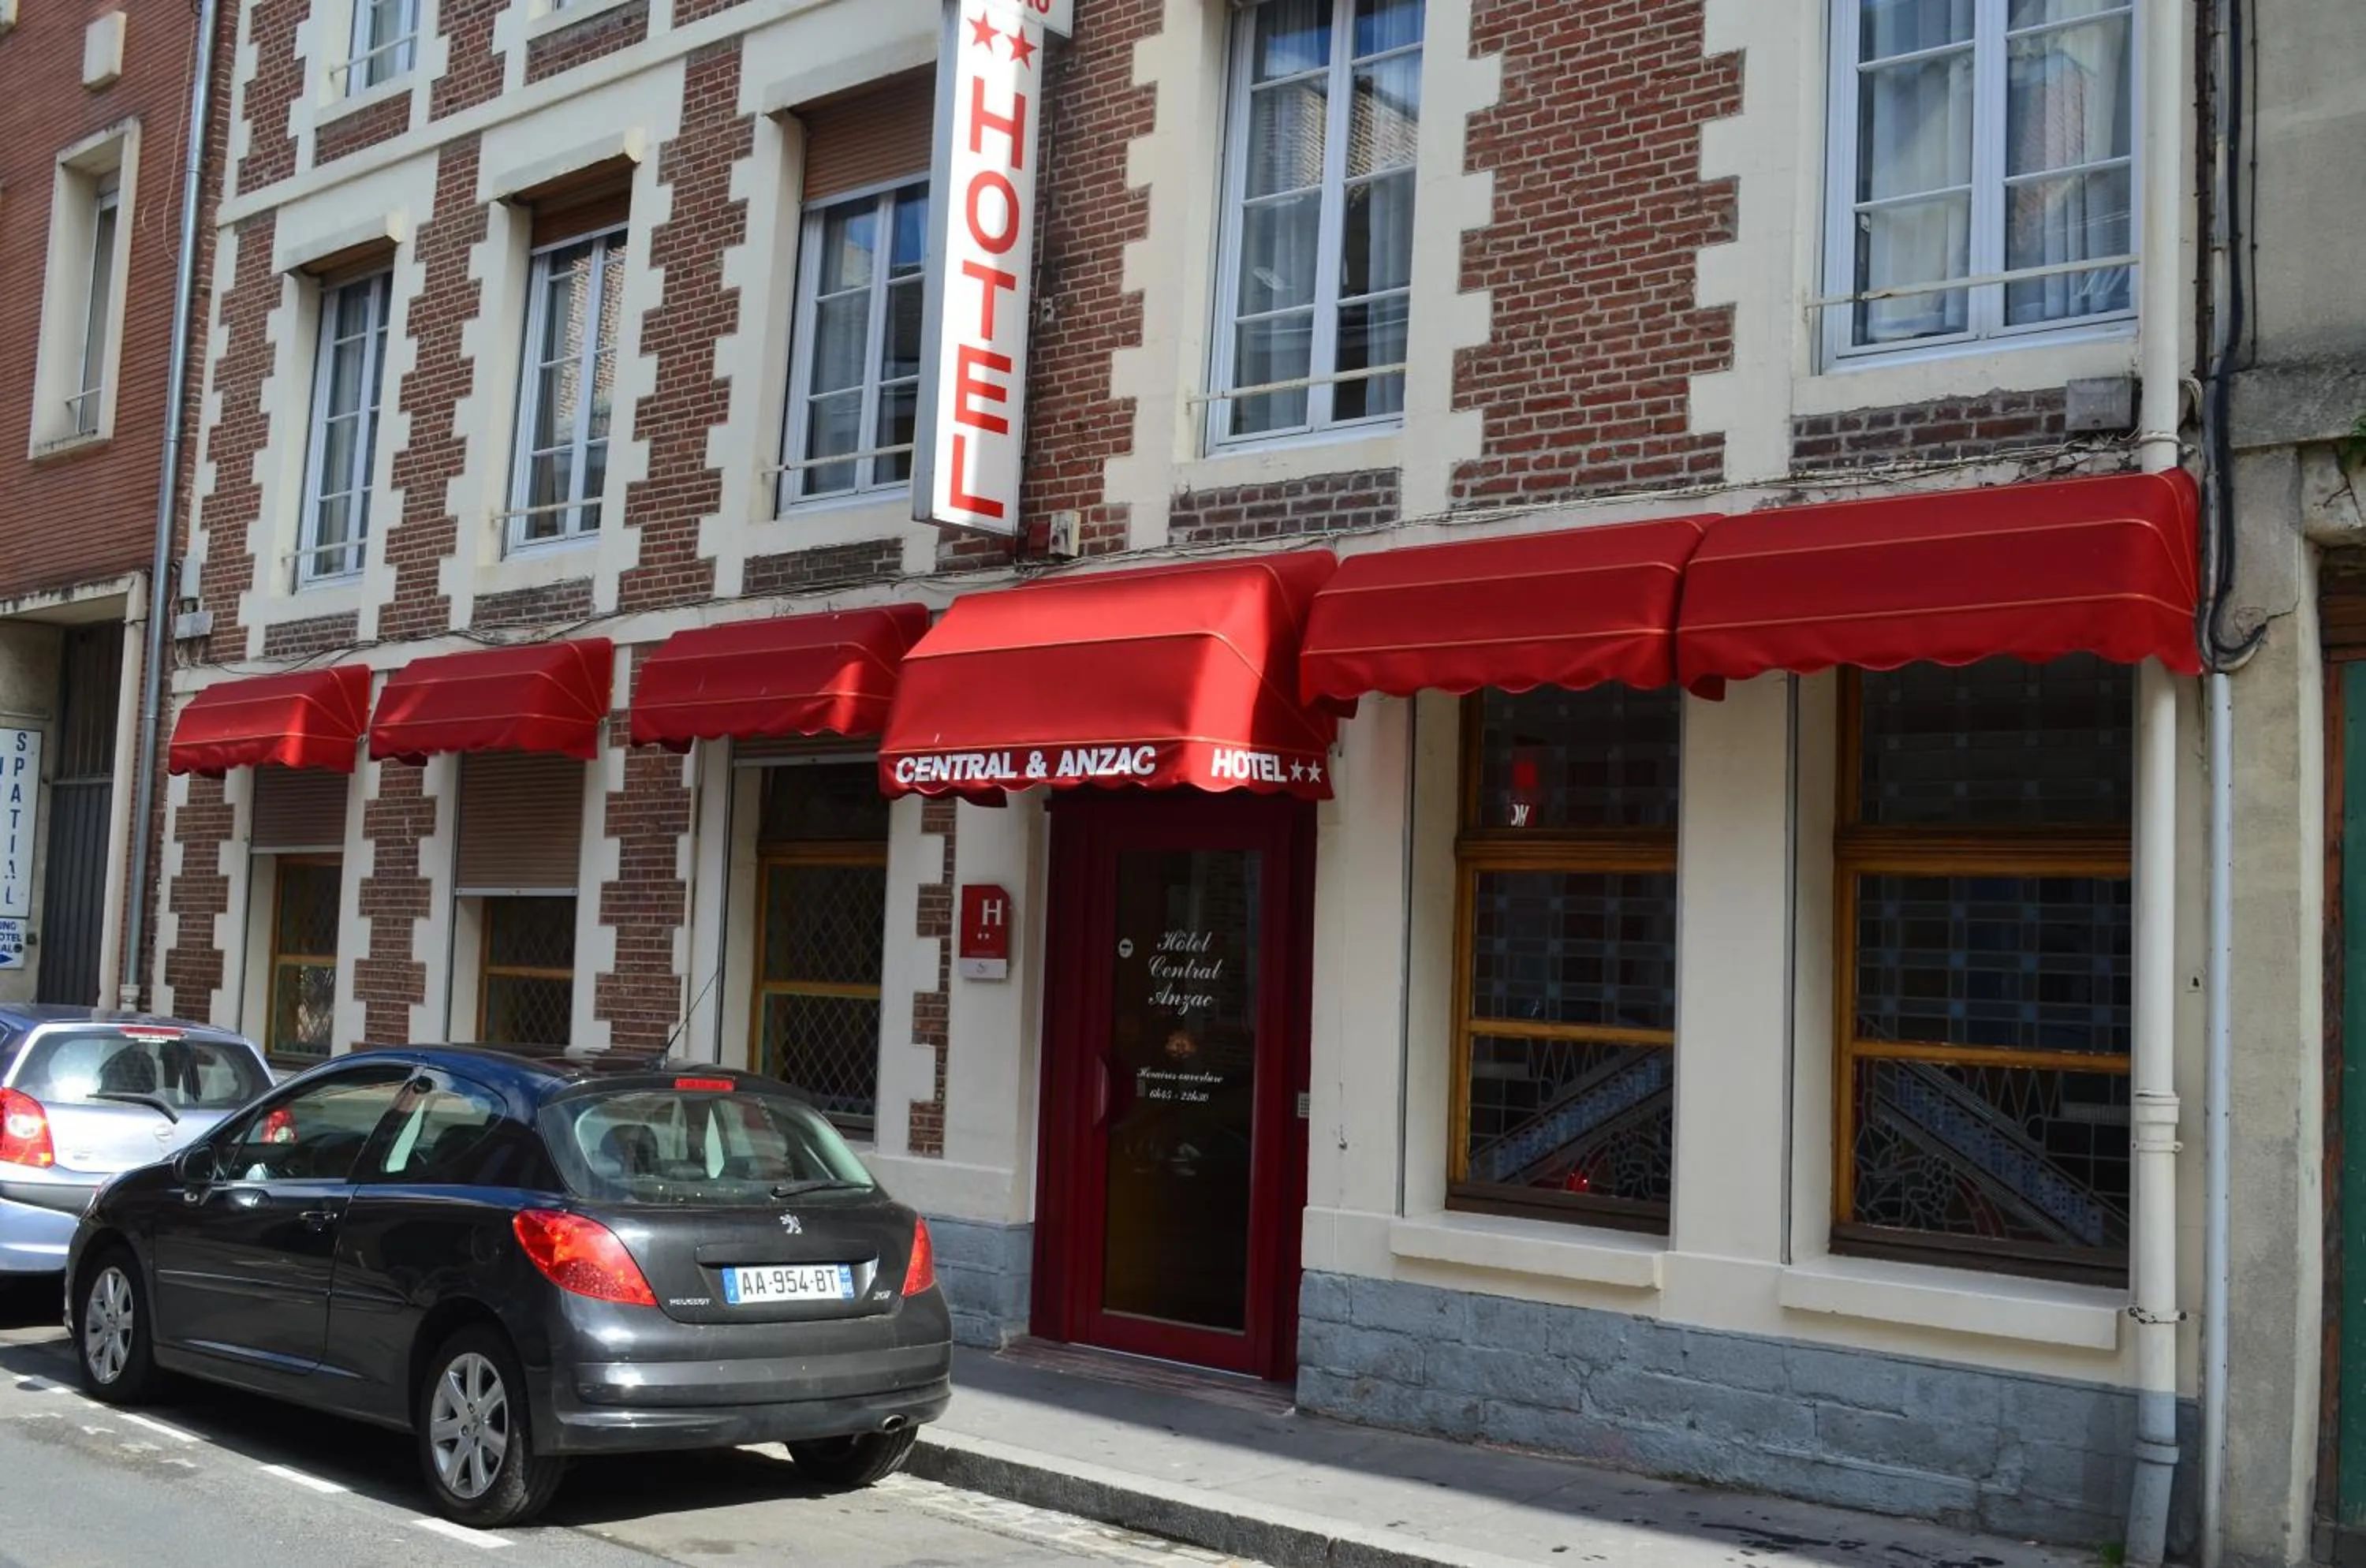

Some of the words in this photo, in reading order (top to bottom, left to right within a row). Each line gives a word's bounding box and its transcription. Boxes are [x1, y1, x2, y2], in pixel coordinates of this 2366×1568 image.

[949, 75, 1027, 519] HOTEL
[896, 752, 1017, 783] CENTRAL
[1026, 750, 1047, 778] &
[1056, 746, 1155, 777] ANZAC
[1211, 748, 1287, 782] HOTEL
[982, 899, 1002, 925] H
[1156, 929, 1212, 953] Hôtel
[1148, 955, 1222, 979] Central
[1148, 983, 1214, 1015] Anzac
[741, 1269, 836, 1296] AA-954-BT
